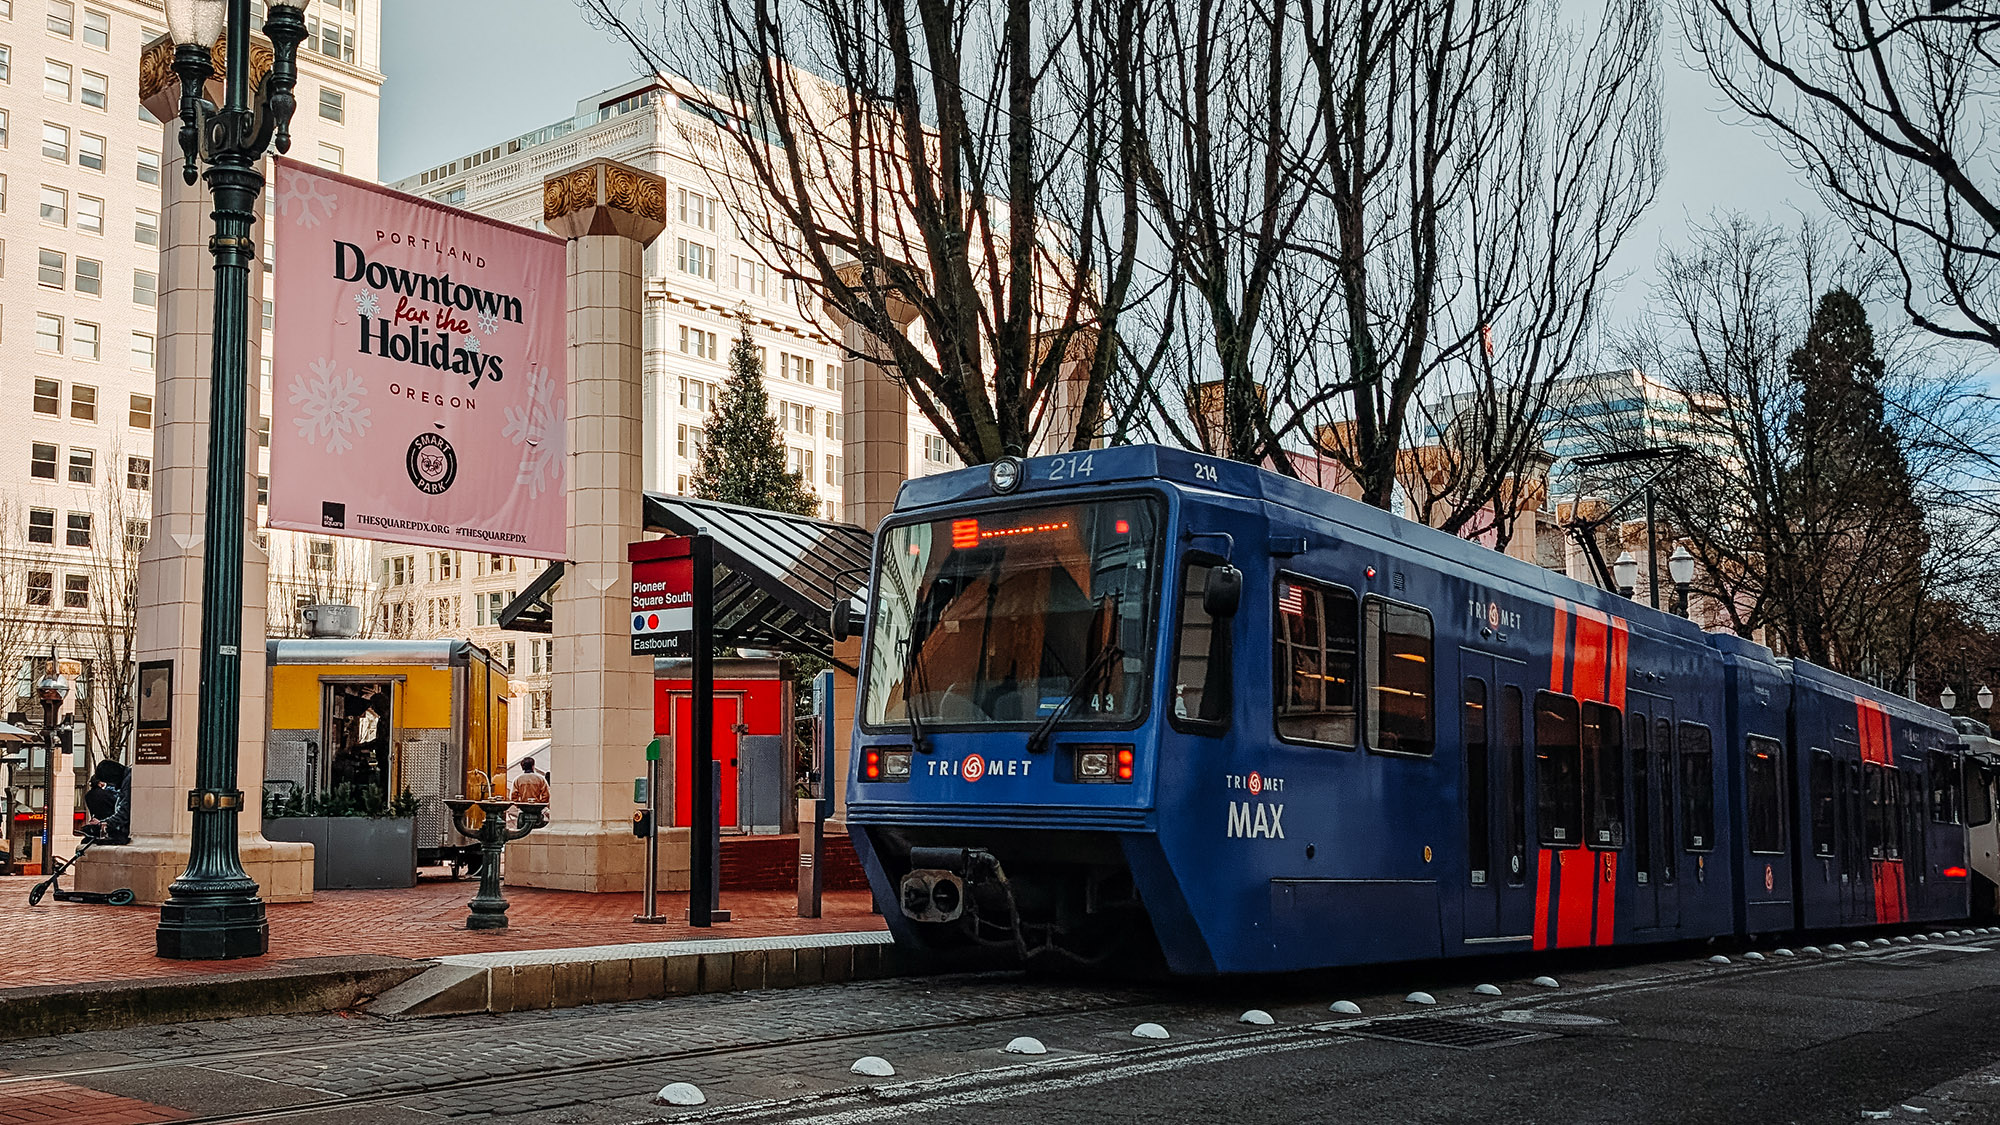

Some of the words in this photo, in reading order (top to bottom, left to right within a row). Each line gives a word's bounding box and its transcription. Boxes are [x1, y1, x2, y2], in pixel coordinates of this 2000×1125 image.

[376, 230, 486, 269] PORTLAND
[333, 239, 524, 325] Downtown
[394, 295, 430, 326] for
[436, 307, 472, 334] the
[358, 314, 504, 391] Holidays
[390, 383, 476, 410] OREGON
[415, 435, 451, 452] SMART
[1049, 454, 1094, 481] 214
[1194, 462, 1218, 483] 214
[417, 479, 446, 493] PARK
[356, 514, 450, 534] THESQUAREPDX.ORG
[455, 528, 527, 543] #THESQUAREPDX
[633, 581, 666, 593] Pioneer
[633, 595, 664, 608] Square
[665, 592, 692, 604] South
[1468, 600, 1487, 620] TRI
[1500, 609, 1521, 630] MET
[633, 636, 678, 650] Eastbound
[927, 760, 958, 776] TRI
[987, 760, 1032, 776] MET
[1227, 801, 1285, 839] MAX
